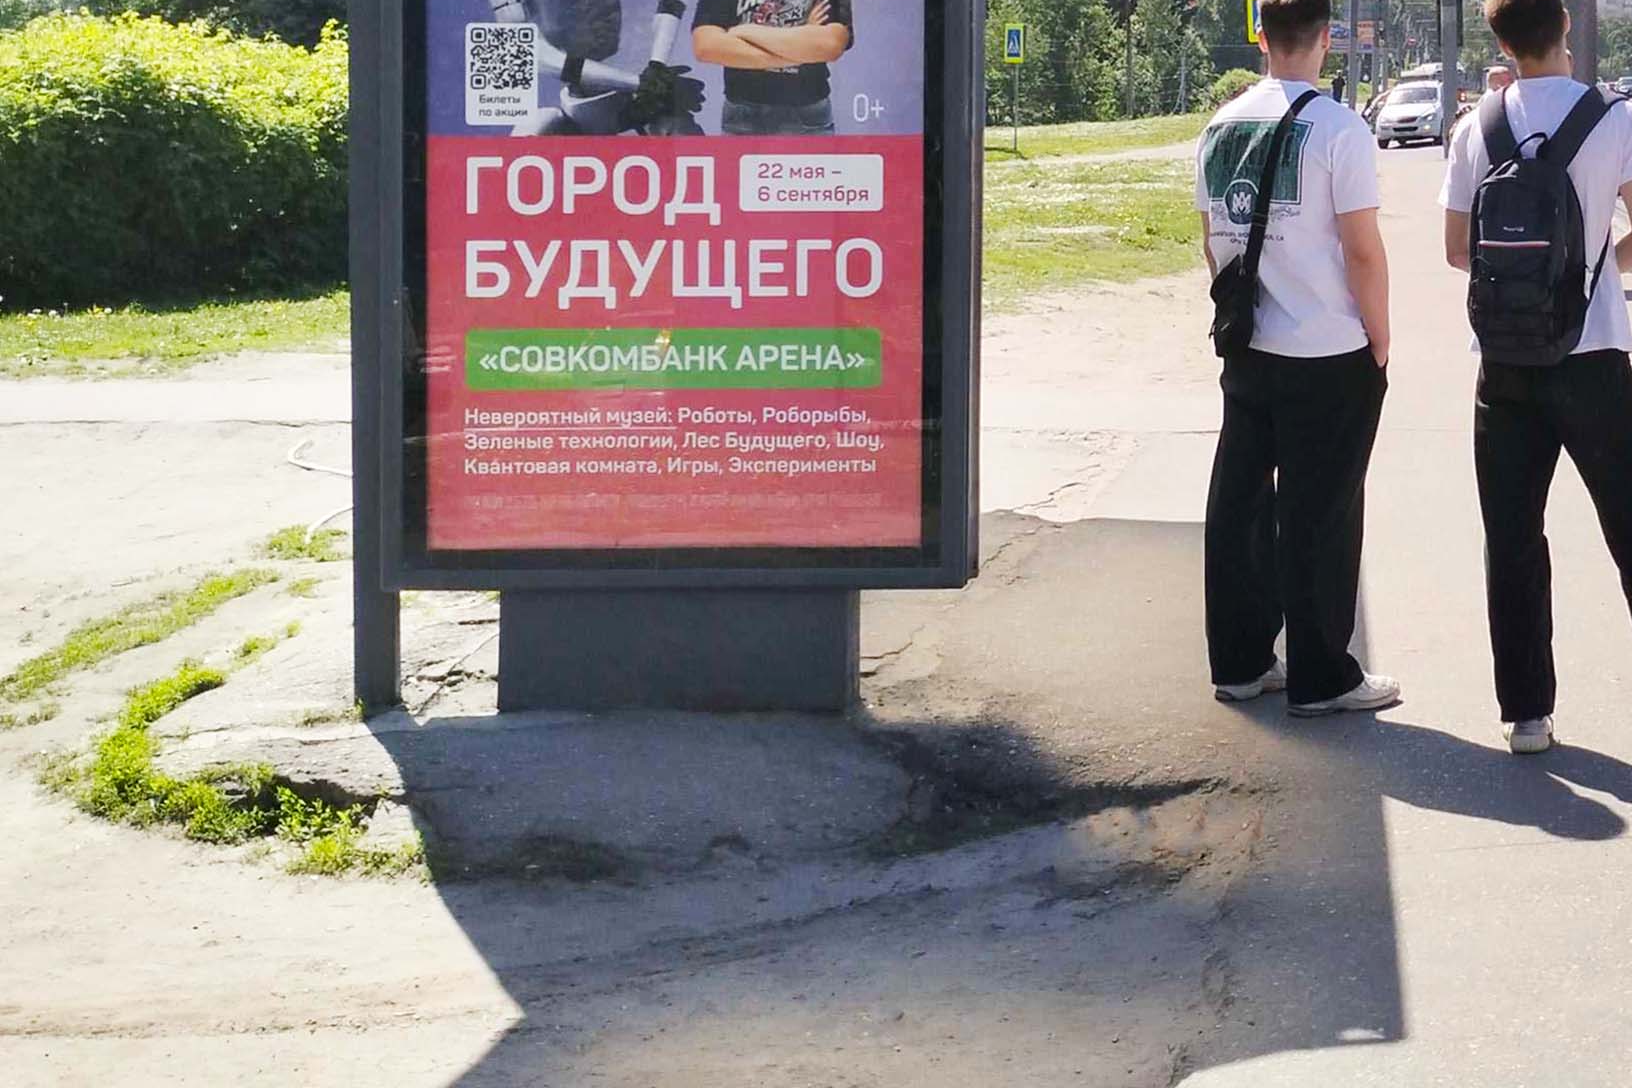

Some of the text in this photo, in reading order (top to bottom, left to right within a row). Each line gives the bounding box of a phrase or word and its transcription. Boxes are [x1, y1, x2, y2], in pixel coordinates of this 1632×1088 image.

[479, 94, 520, 104] Билеты
[853, 93, 885, 122] 0+
[479, 109, 528, 118] по акции
[757, 163, 783, 179] 22
[789, 166, 825, 179] мая
[466, 155, 721, 226] ГОРОД
[757, 185, 869, 205] 6 сентября
[466, 238, 883, 309] БУДУЩЕГО
[479, 344, 865, 372] «СОВКОМБАНК АРЕНА»
[464, 406, 872, 428] Невероятный музей: Роботы, Роборыбы,
[464, 432, 885, 453] Зеленые технологии, Лес Будущего, Шоу,
[464, 457, 876, 477] Квантовая комната, Игры, Эксперименты
